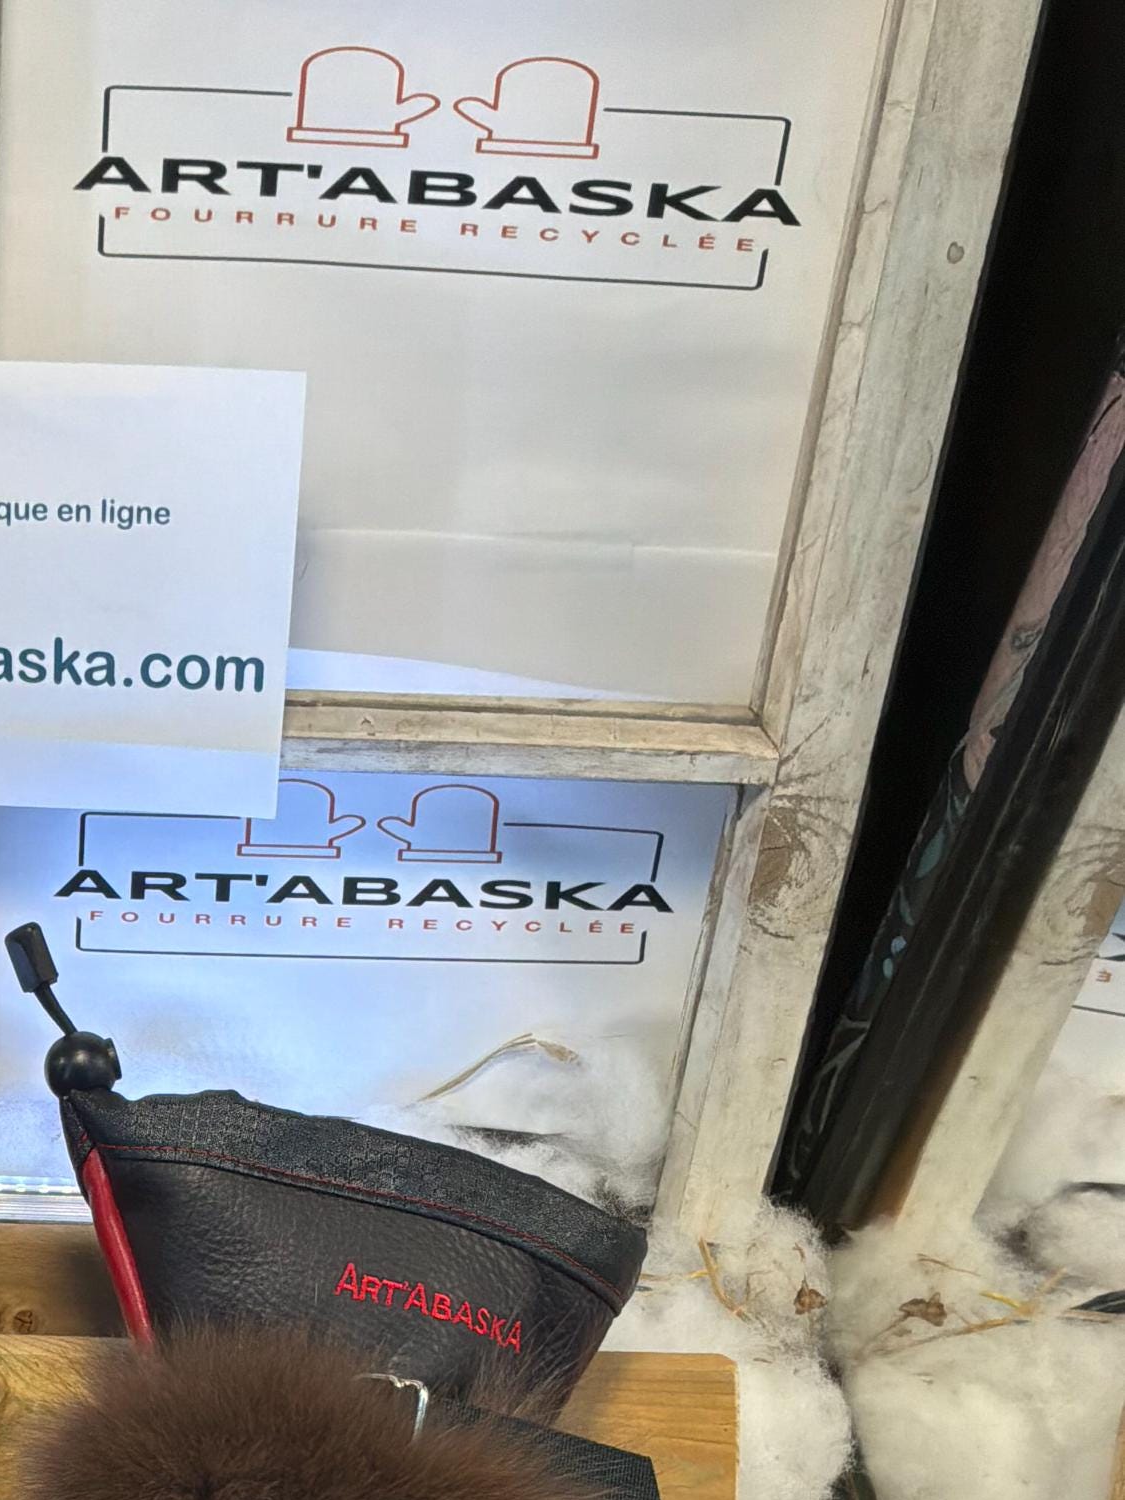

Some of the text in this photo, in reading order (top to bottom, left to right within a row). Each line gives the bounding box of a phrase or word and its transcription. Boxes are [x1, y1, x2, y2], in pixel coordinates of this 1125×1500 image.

[74, 155, 802, 228] ART'ABASKA
[114, 206, 756, 253] FOURRURE RECYCLÉE
[57, 503, 91, 523] en
[101, 498, 171, 530] ligne
[54, 868, 675, 914] ART'ABASKA
[89, 909, 636, 936] FOURRURE RECYCLÉE
